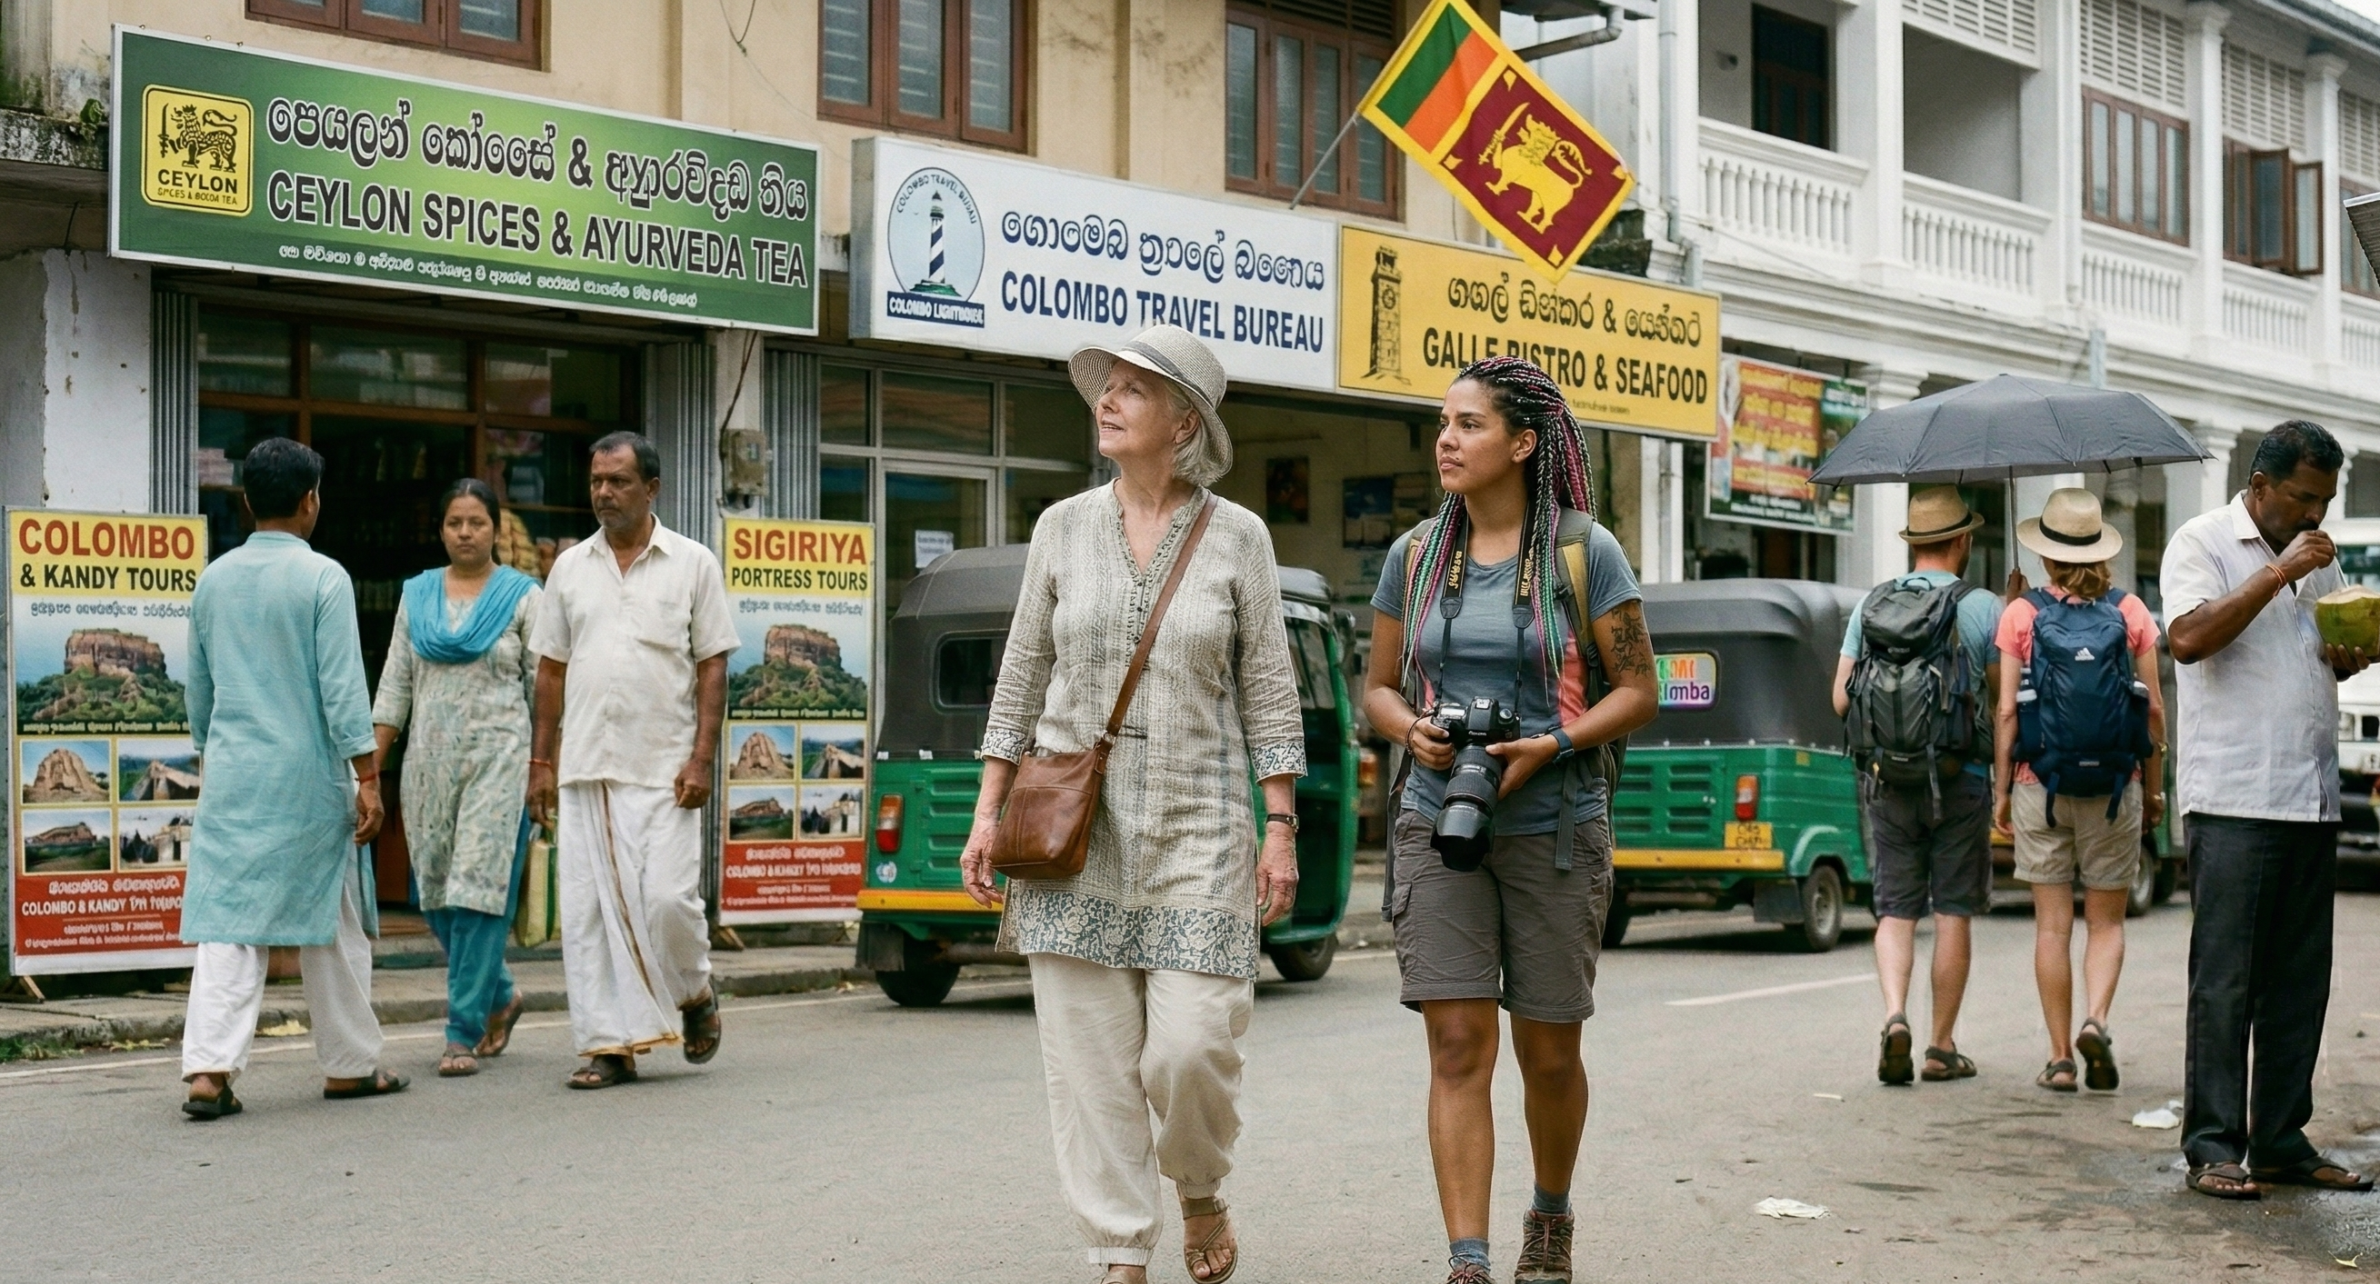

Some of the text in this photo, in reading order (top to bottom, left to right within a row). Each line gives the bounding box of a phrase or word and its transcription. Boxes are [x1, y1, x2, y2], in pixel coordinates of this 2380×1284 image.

[568, 137, 594, 188] &
[158, 169, 237, 194] CEYLON
[269, 171, 411, 235] CEYLON
[423, 192, 540, 252] SPICES
[552, 211, 573, 256] &
[582, 215, 745, 279] AYURVEDA
[752, 239, 807, 287] TEA
[889, 296, 932, 318] COLOMBO
[1001, 270, 1324, 353] COLOMBO TRAVEL BUREAU
[1602, 298, 1617, 334] &
[1423, 327, 1499, 369] GALLE
[1594, 353, 1608, 390] &
[1615, 356, 1708, 404] SEAFOOD
[19, 518, 194, 560] COLOMBO
[733, 527, 867, 565] SIGIRIYA
[20, 563, 197, 592] & KANDY TOURS
[732, 566, 868, 591] PORTRESS TOURS
[21, 901, 76, 916] COLOMBO
[78, 900, 87, 914] &
[88, 898, 127, 913] KANDY
